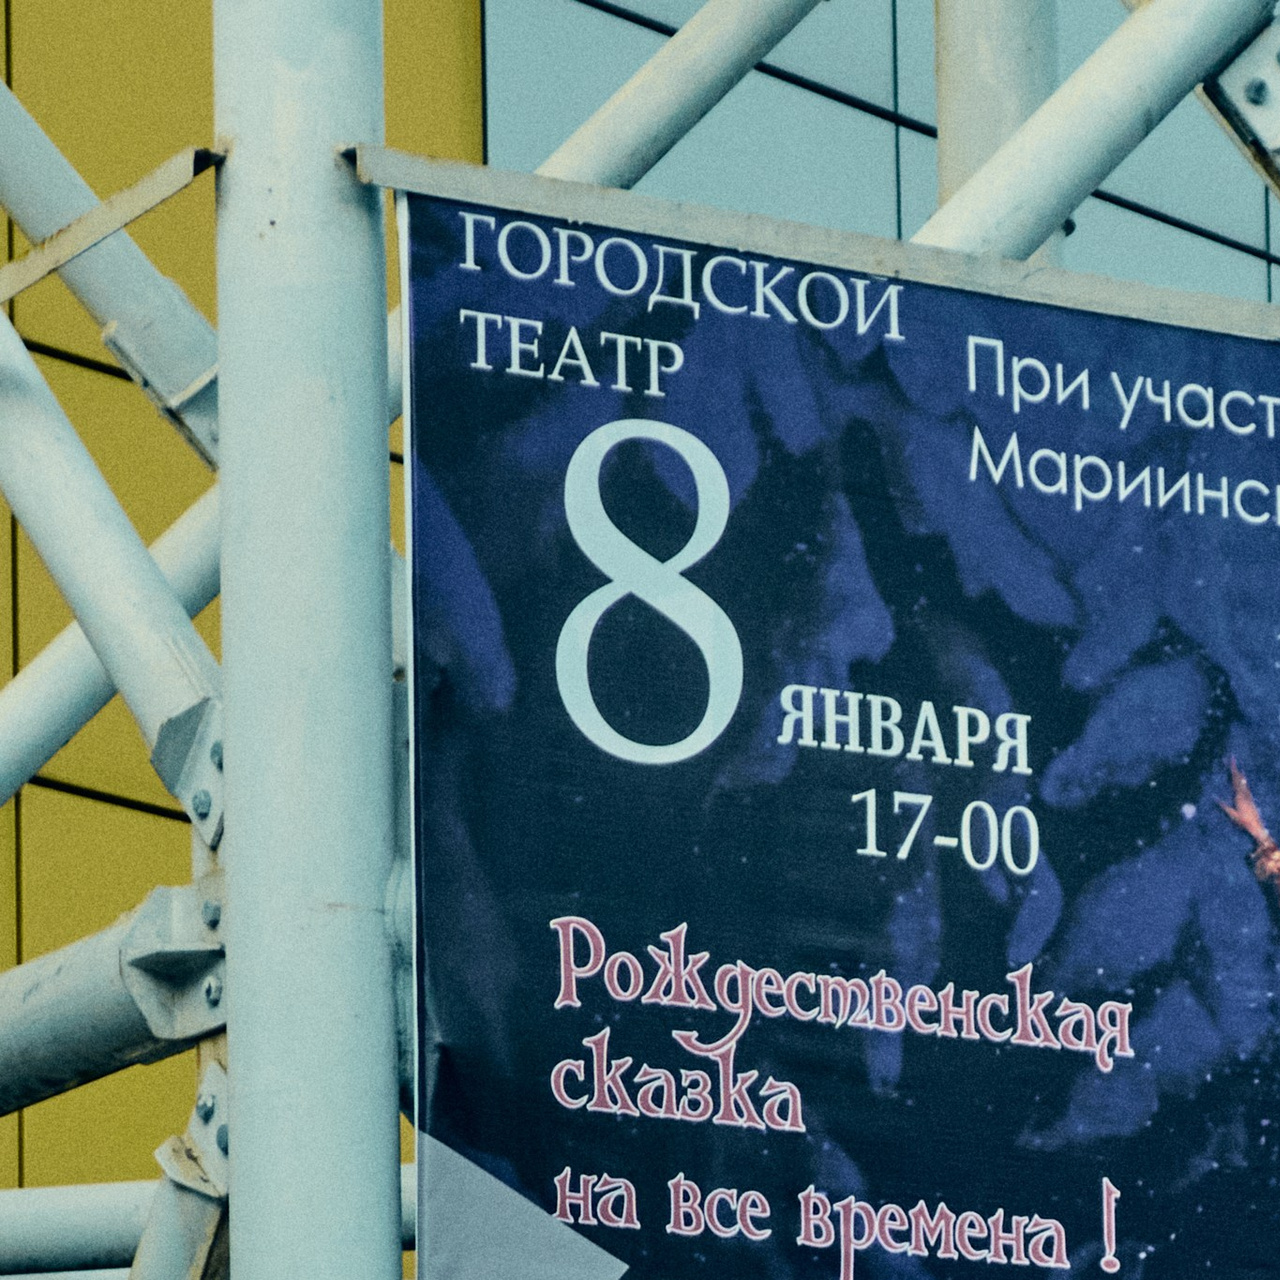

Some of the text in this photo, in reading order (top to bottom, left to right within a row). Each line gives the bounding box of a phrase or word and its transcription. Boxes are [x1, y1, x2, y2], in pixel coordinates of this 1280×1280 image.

[457, 210, 906, 341] ГОРОДСКОЙ
[459, 308, 685, 397] ТЕАТР
[967, 335, 1091, 413] При
[555, 418, 744, 765] 8
[776, 683, 1034, 775] ЯНВАРЯ
[850, 787, 1041, 875] 17-00
[549, 914, 1135, 1072] Рождественская
[550, 1026, 806, 1132] сказка
[552, 1165, 641, 1230] на
[666, 1171, 772, 1239] все
